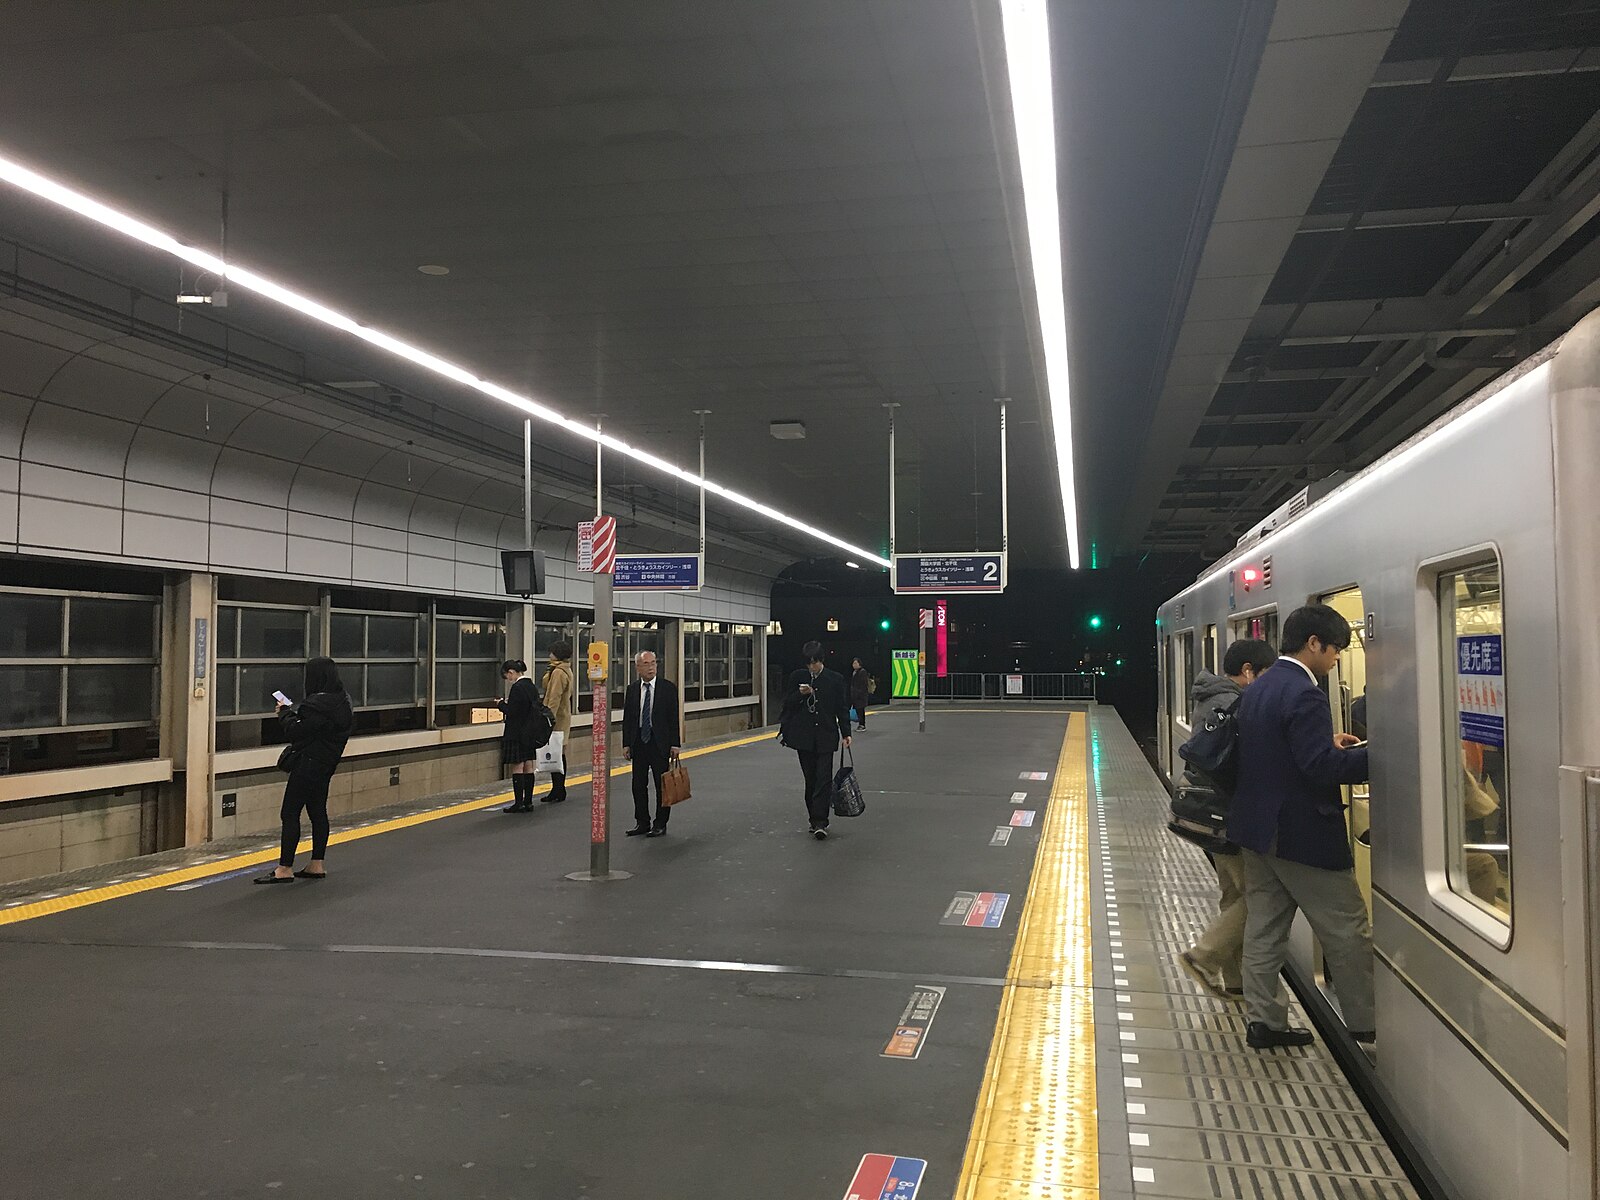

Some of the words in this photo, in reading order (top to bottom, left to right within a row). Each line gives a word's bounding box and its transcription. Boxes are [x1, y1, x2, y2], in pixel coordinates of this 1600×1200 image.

[983, 562, 998, 581] 2
[1460, 640, 1492, 672] 優先席
